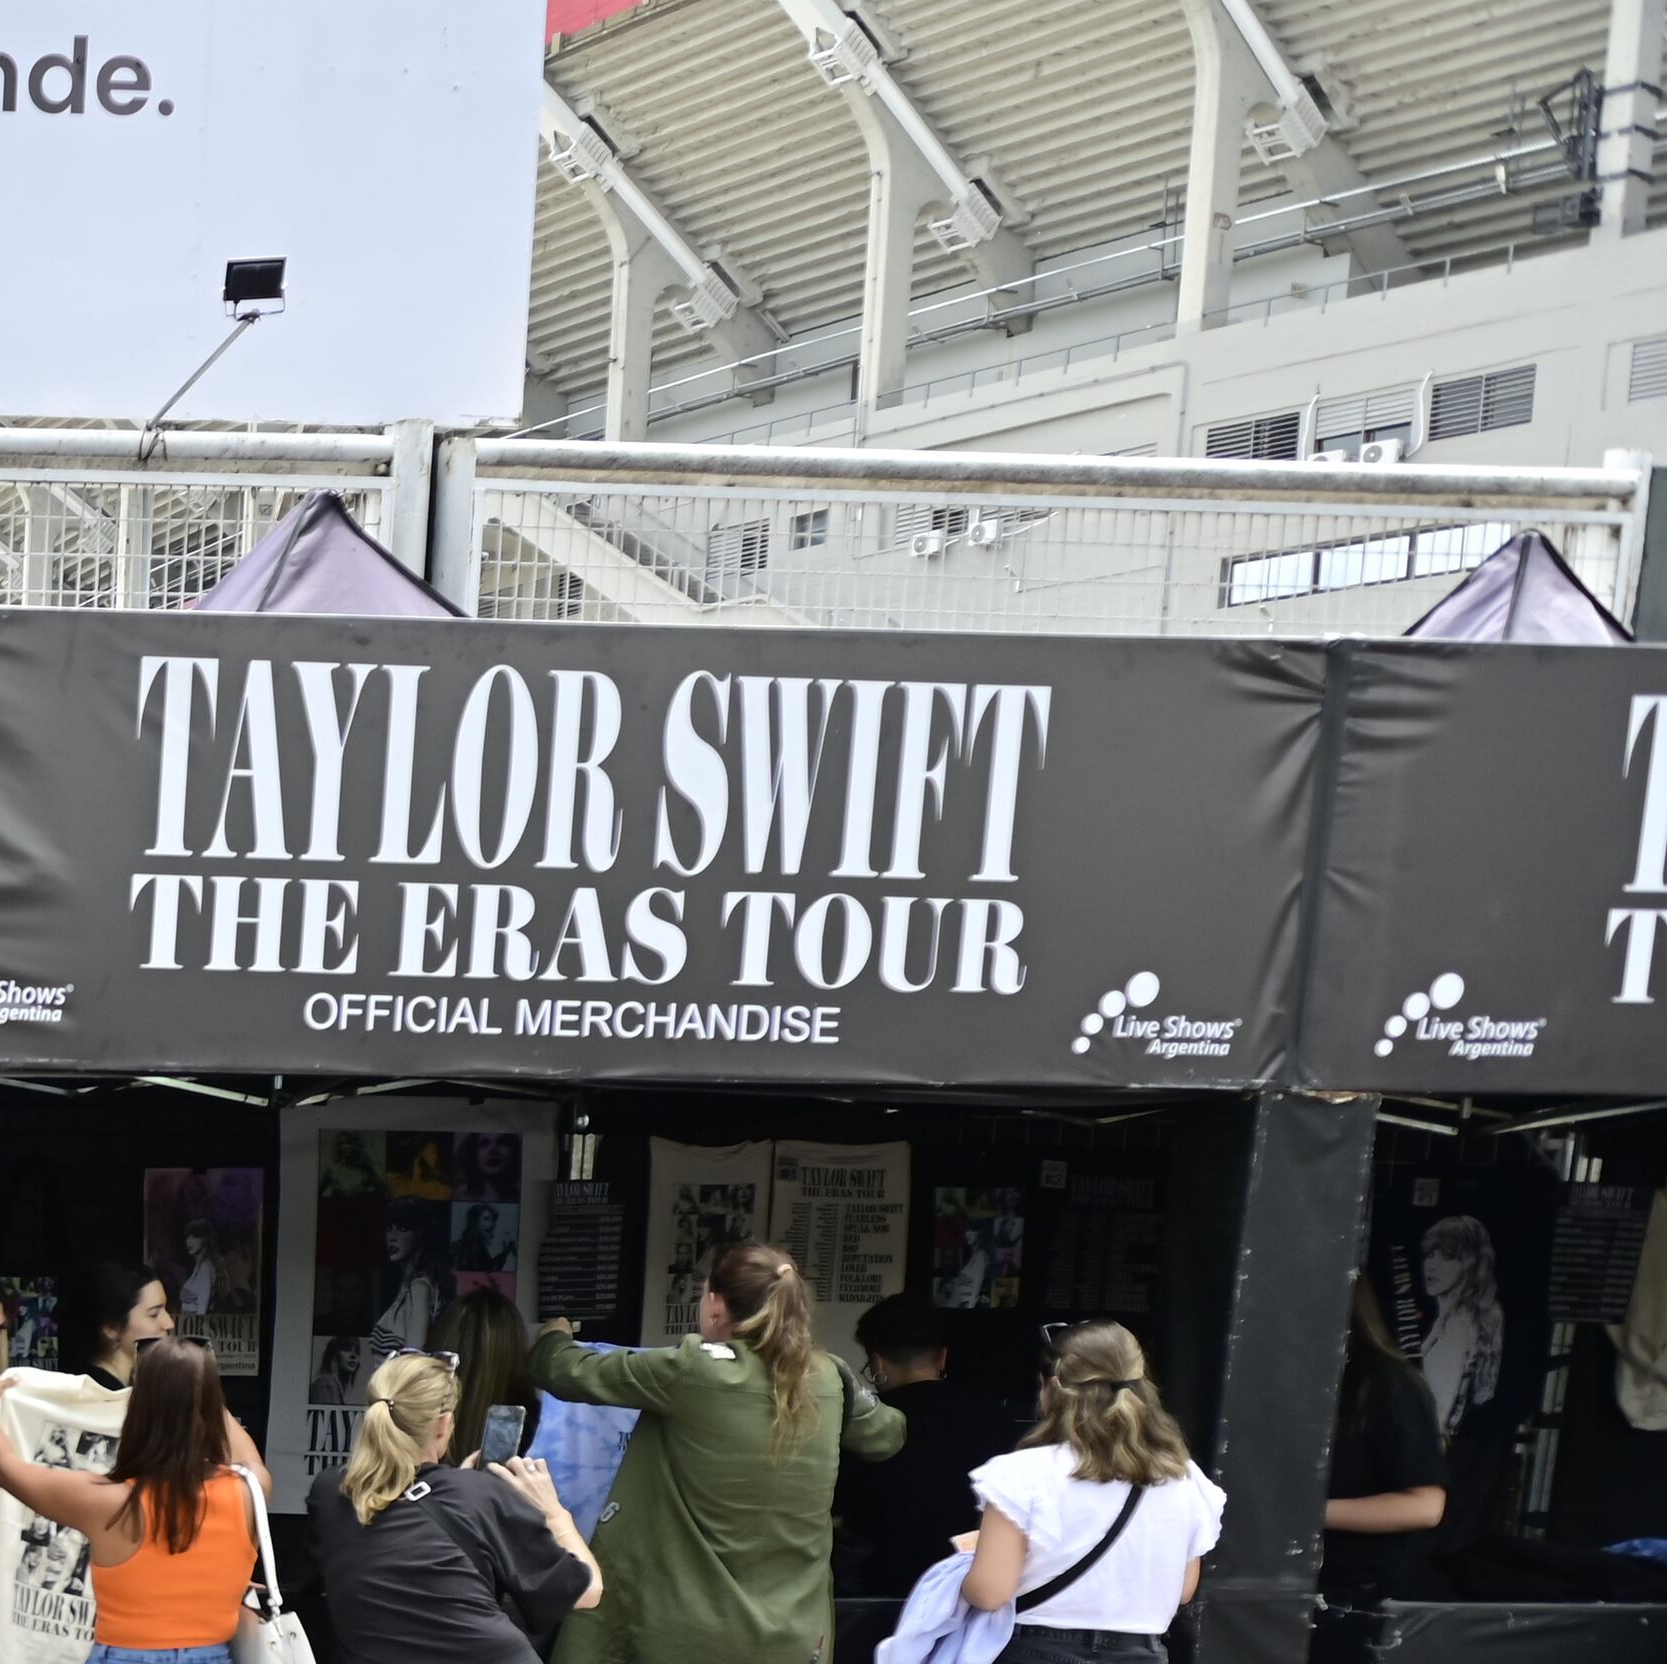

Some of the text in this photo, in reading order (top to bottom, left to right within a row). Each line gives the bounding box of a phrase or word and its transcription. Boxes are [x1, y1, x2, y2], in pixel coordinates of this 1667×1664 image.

[133, 656, 1052, 882] TAYLOR SWIFT
[130, 874, 1027, 994] THE ERAS TOUR
[304, 993, 840, 1043] OFFICIAL MERCHANDISE
[1113, 1014, 1155, 1038] Live
[1415, 1017, 1458, 1041] Live
[1146, 1038, 1230, 1058] Argentina
[1450, 1040, 1534, 1059] Argentina
[802, 1167, 885, 1188] TAYLOR SWIFT
[307, 1409, 364, 1452] TAY
[13, 1583, 65, 1621] TAYLOR
[33, 1618, 70, 1638] ERAS
[75, 1628, 95, 1641] TO
